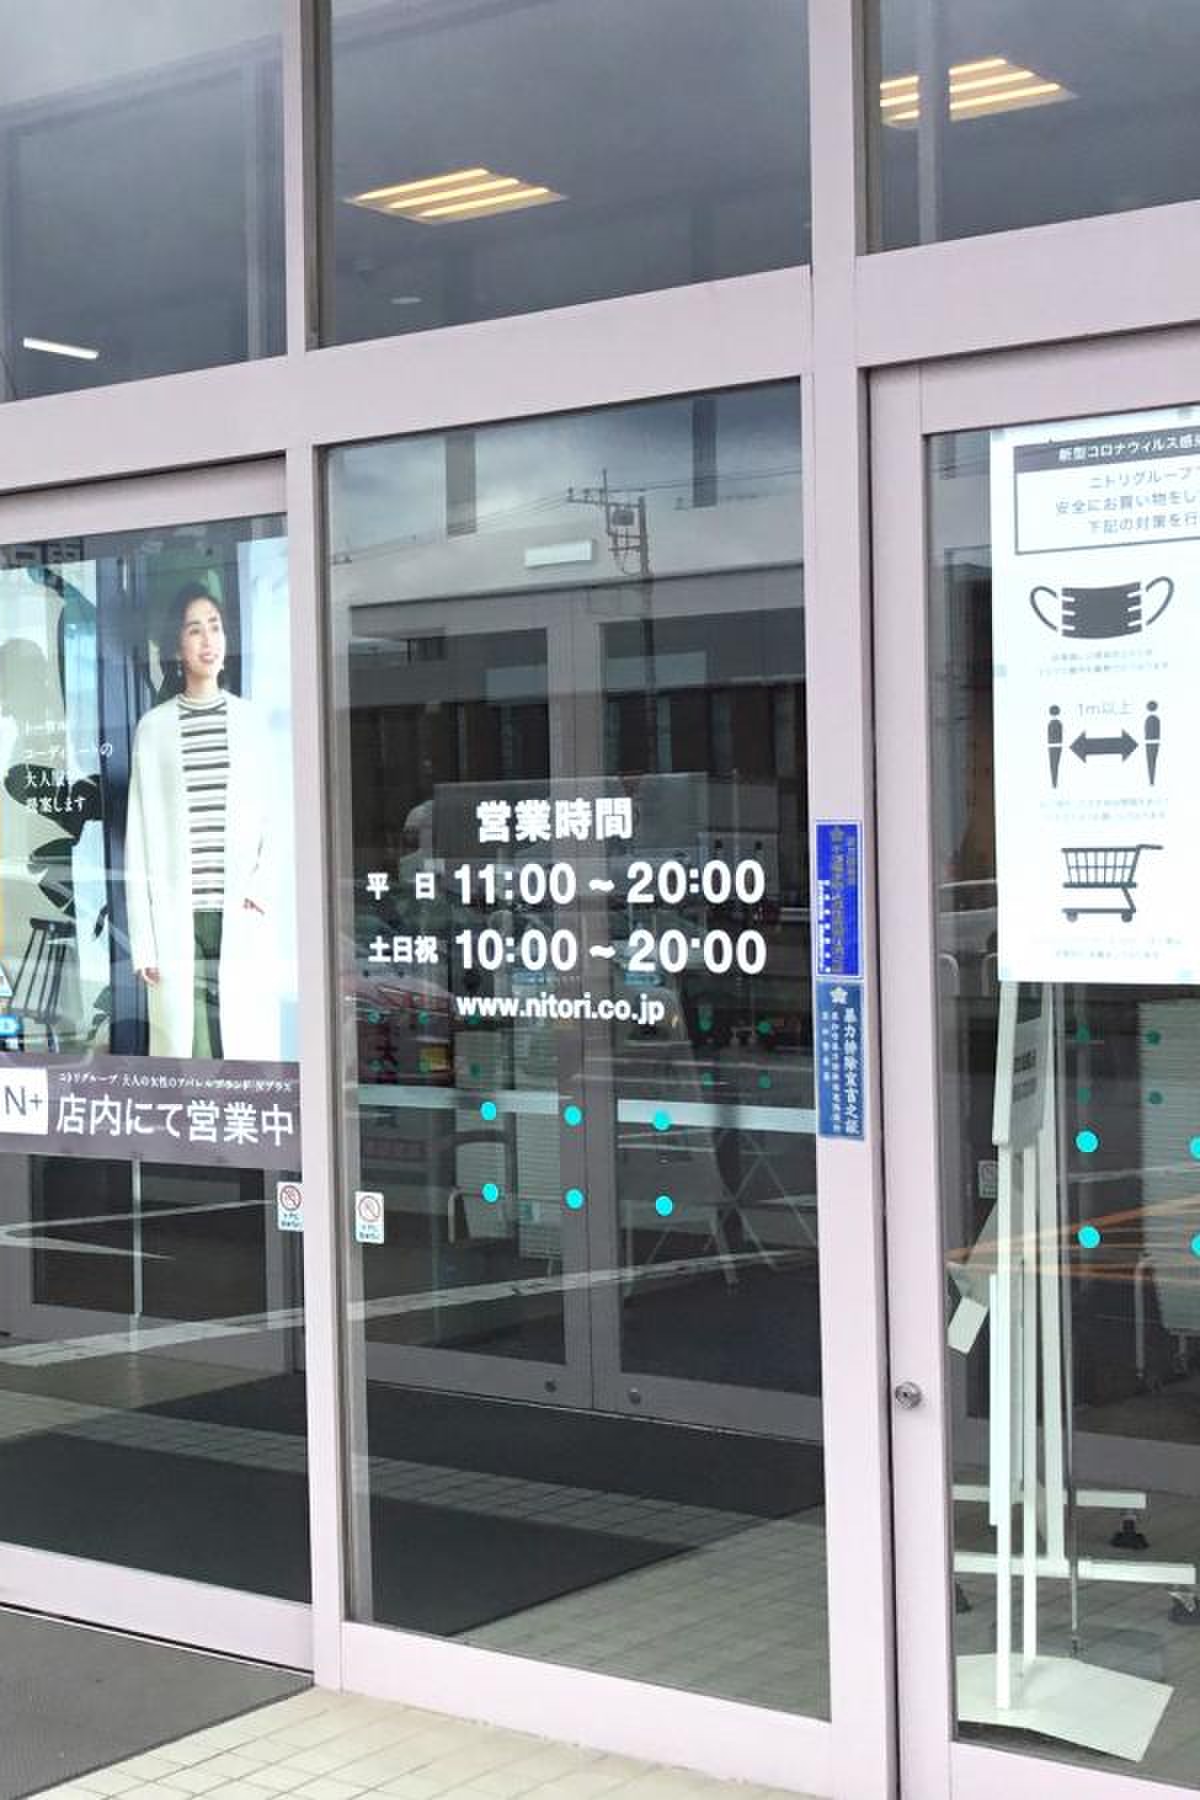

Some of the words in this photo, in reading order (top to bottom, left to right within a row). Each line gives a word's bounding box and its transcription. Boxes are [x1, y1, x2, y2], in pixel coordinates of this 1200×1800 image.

[1056, 491, 1200, 514] 安全にお買い物をし
[476, 797, 632, 842] 営業時間
[369, 937, 437, 964] 土日祝
[457, 993, 664, 1024] www.nitori.co.jp
[3, 1086, 43, 1116] N+
[56, 1094, 294, 1146] 店内にて営業中
